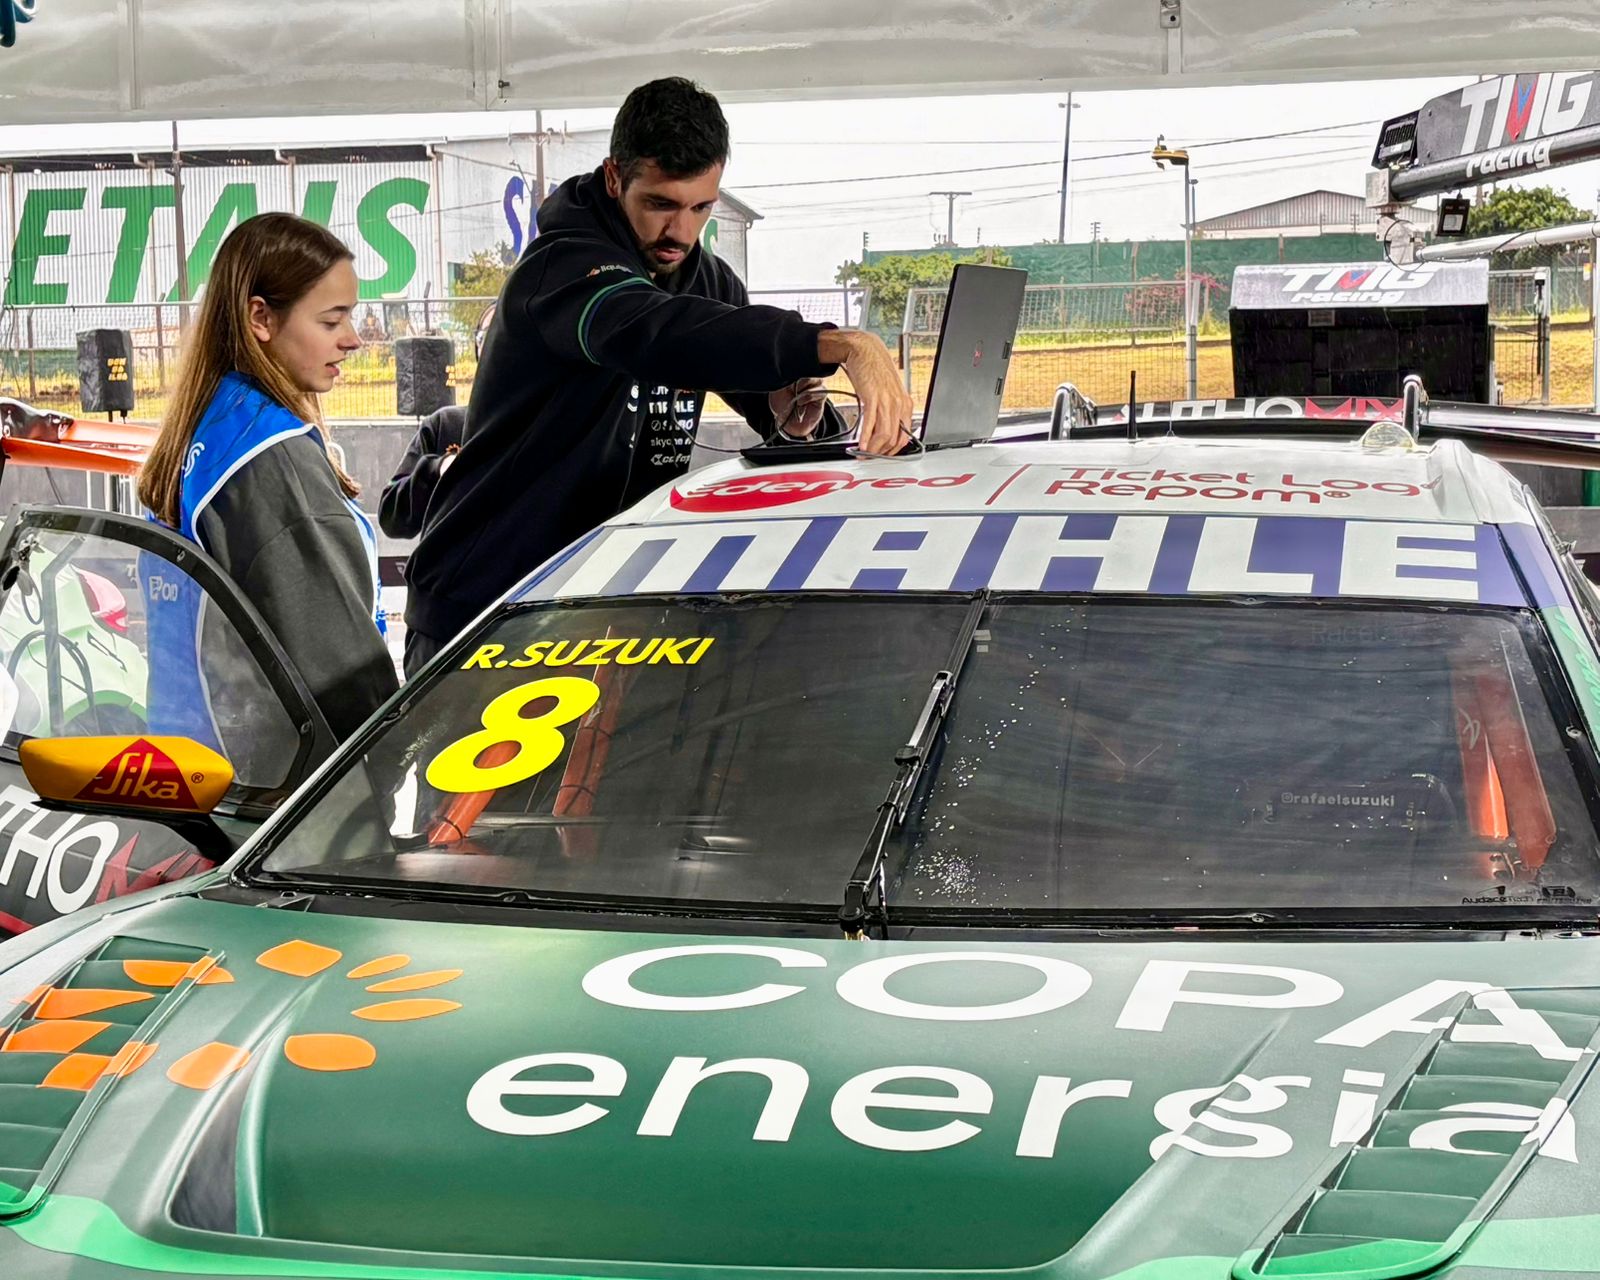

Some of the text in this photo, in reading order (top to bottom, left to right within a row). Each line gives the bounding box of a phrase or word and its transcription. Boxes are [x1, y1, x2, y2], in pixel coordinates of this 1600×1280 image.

[1460, 71, 1594, 156] TMG
[1465, 138, 1556, 178] racing
[1282, 267, 1439, 291] TMG
[1290, 290, 1405, 304] racing
[1061, 467, 1420, 496] Ticket Log
[553, 515, 1479, 600] MAHLE
[460, 637, 716, 670] R.SUZUKI
[425, 676, 600, 793] 8
[93, 752, 180, 800] Sika
[581, 944, 1595, 1062] COPA
[466, 1051, 1579, 1164] energia
